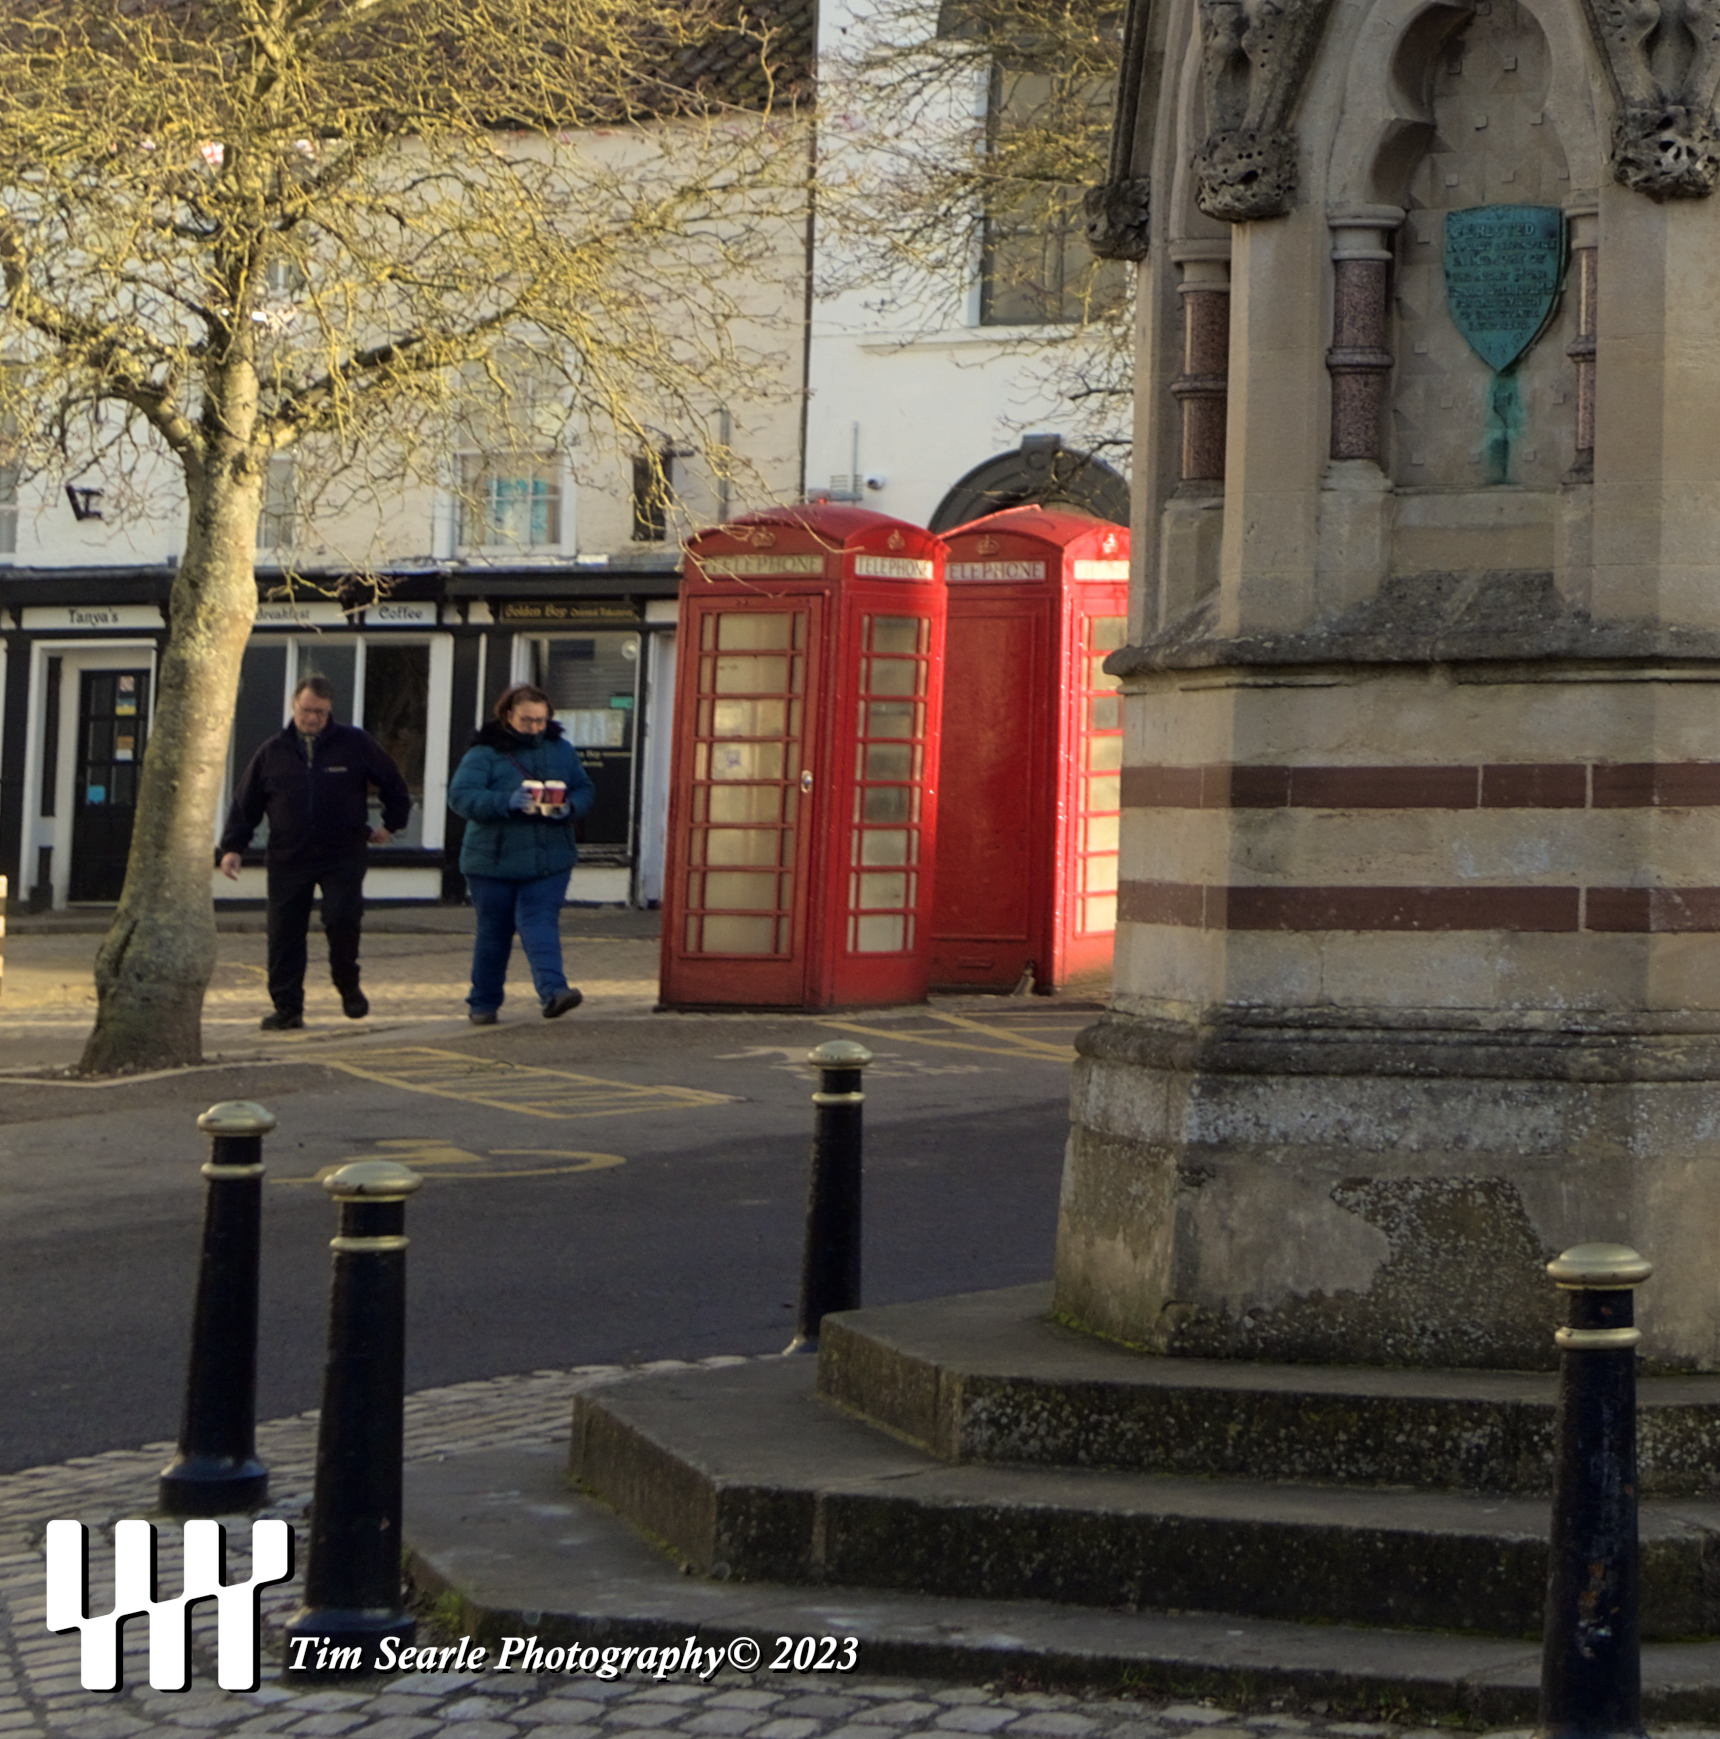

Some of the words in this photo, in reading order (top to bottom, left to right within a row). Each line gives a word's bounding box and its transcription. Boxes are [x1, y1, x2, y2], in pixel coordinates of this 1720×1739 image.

[706, 554, 821, 574] TELEPHONE
[856, 555, 930, 577] TELEPHONE
[948, 561, 1044, 580] ELEPHONE
[68, 607, 119, 627] Tanya's
[378, 606, 423, 620] Coffee
